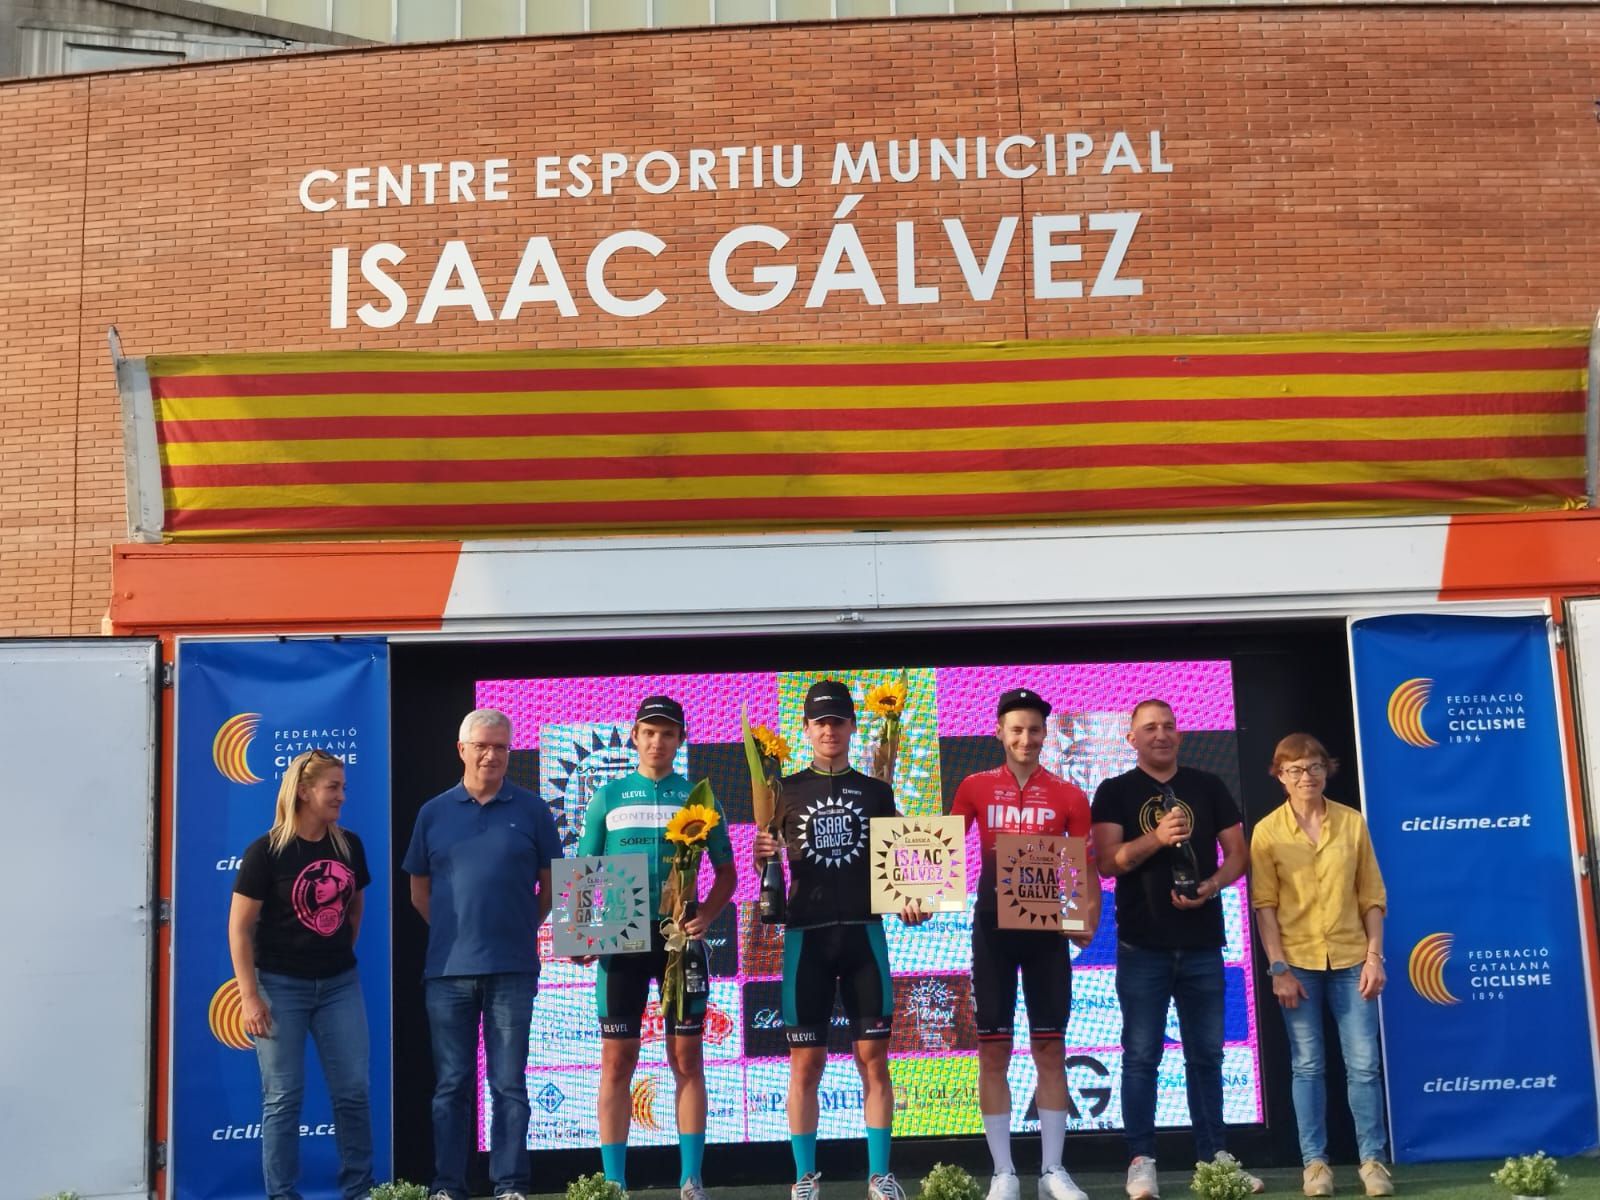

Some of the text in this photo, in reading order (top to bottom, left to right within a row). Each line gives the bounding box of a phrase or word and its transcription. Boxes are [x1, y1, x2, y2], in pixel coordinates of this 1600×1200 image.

[298, 129, 1174, 212] CENTRE ESPORTIU MUNICIPAL
[329, 194, 1144, 329] ISAAC GÁLVEZ
[1447, 692, 1524, 705] FEDERACIÓ
[1447, 706, 1525, 717] CATALANA
[1449, 718, 1527, 731] CICLISME
[274, 727, 358, 740] FEDERACIÓ
[1449, 734, 1481, 744] 1896
[274, 741, 358, 752] CATALANA
[812, 814, 853, 837] ISAAC
[1401, 813, 1532, 832] ciclisme.cat
[815, 831, 854, 849] GALVEZ
[893, 848, 943, 867] ISAAC
[892, 866, 944, 882] GALVEZ
[1468, 946, 1550, 960] FEDERACIÓ
[1469, 961, 1550, 973] CATALANA
[1471, 973, 1552, 988] CICLISME
[1472, 991, 1505, 1001] 1896
[1423, 1074, 1558, 1093] ciclisme.cat
